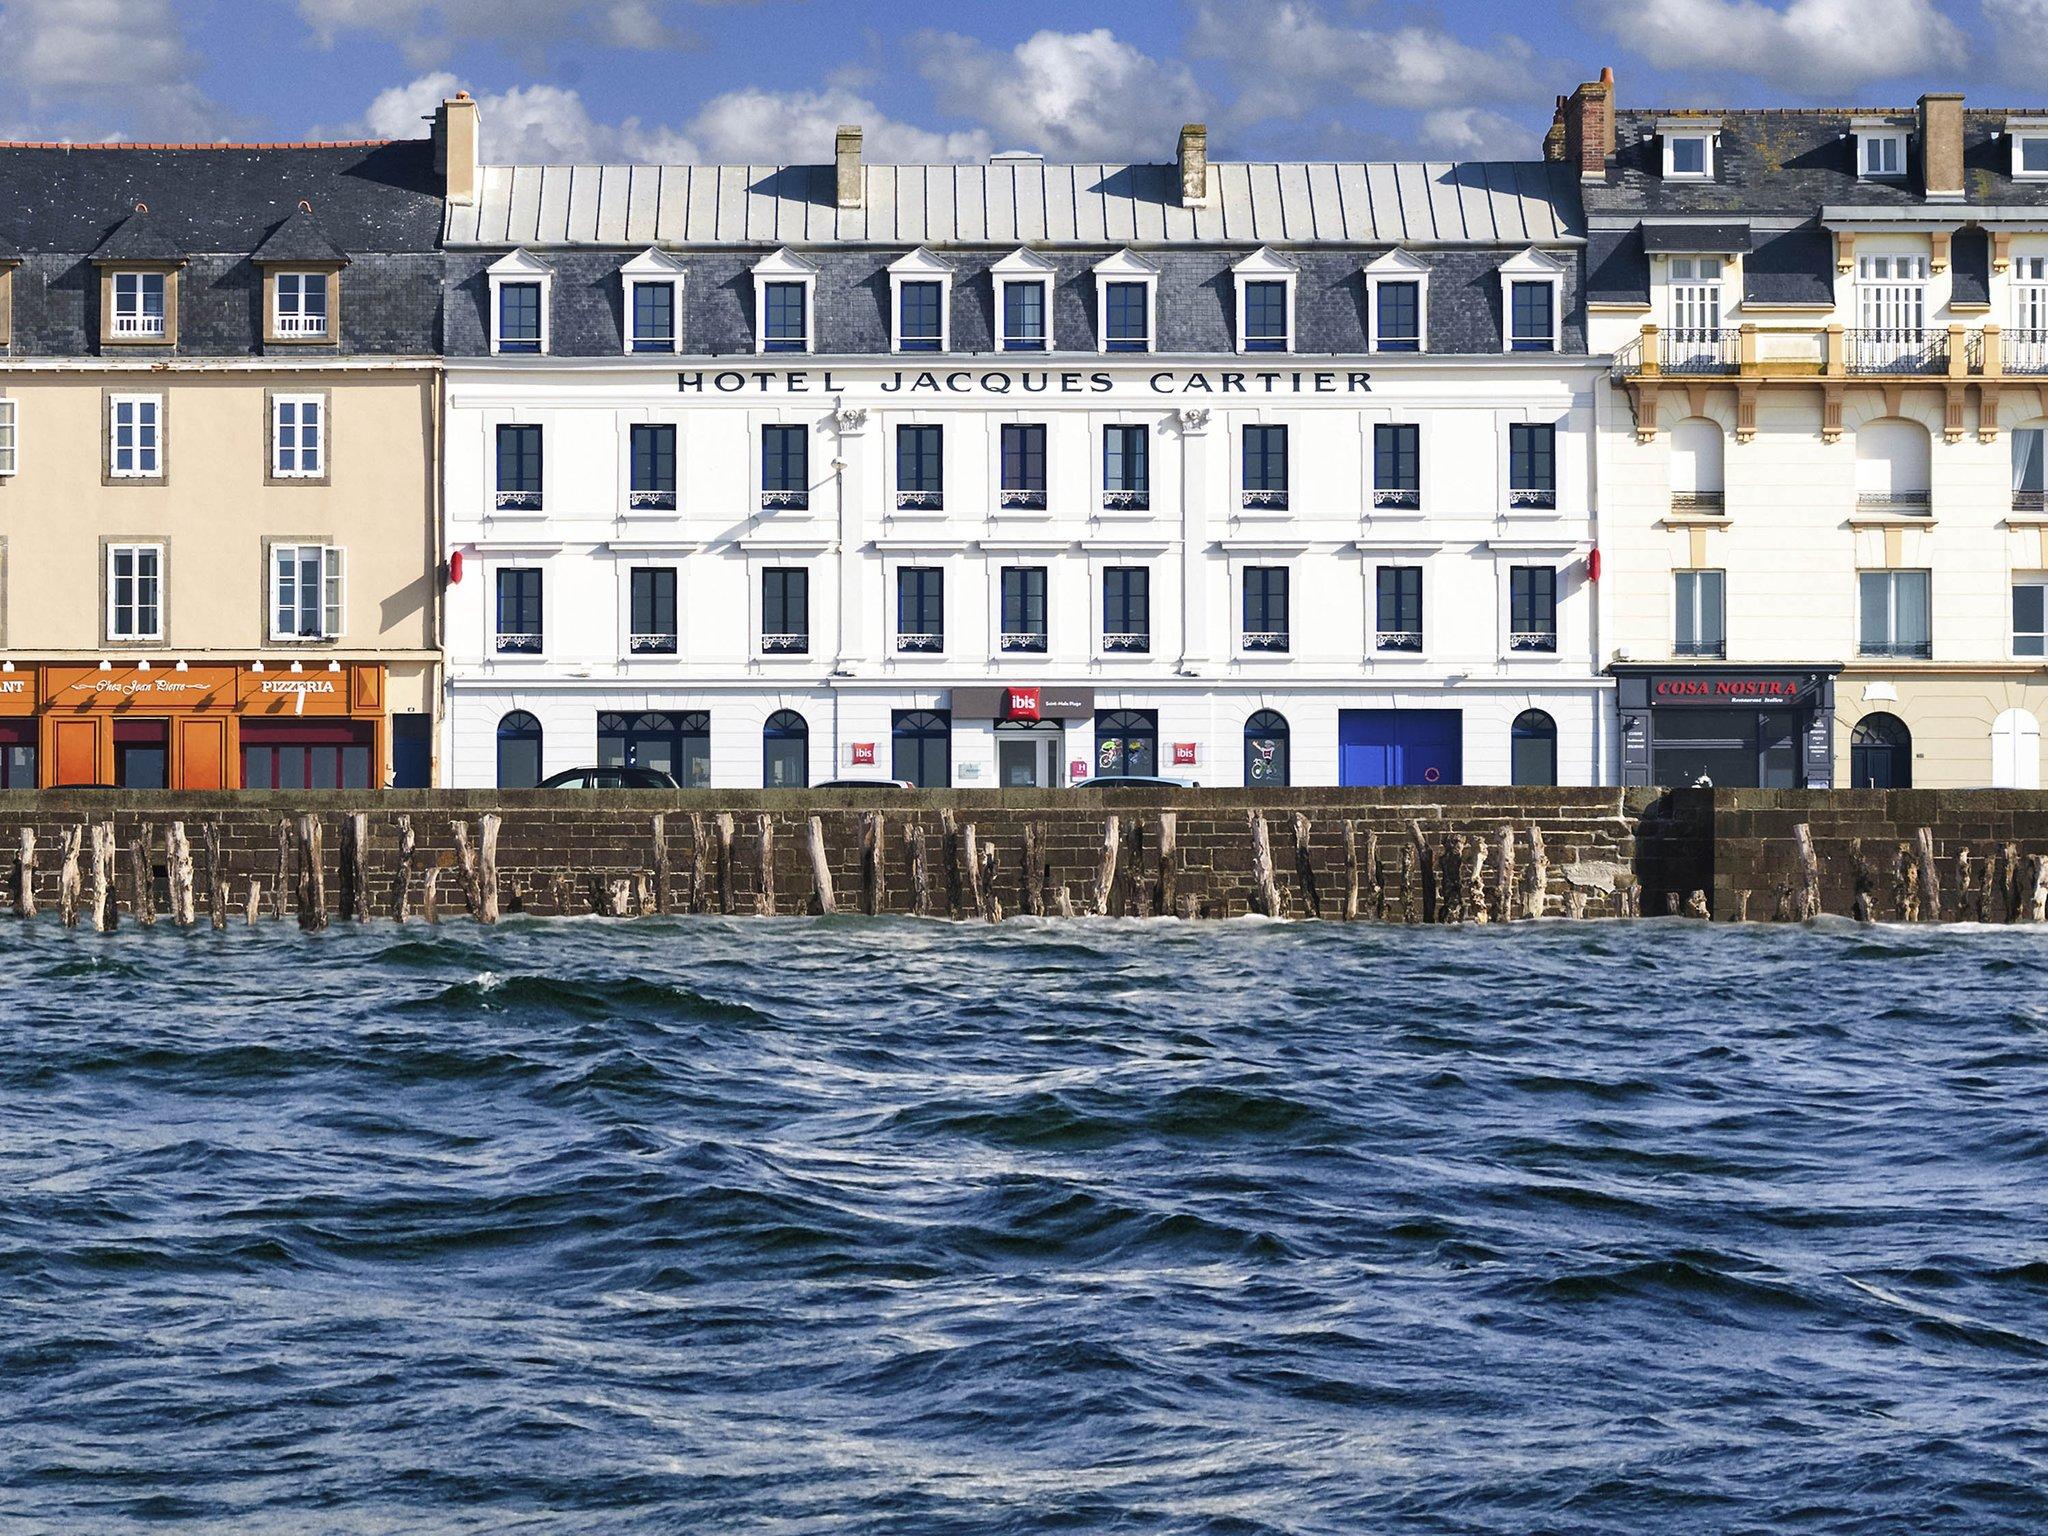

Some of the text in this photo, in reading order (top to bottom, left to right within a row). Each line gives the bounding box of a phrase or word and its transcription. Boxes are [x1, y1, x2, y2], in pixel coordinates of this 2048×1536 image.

[677, 372, 1372, 393] HOTEL JACQUES CARTIER
[0, 681, 24, 693] NT
[95, 680, 185, 695] Chez Jean Pierre
[1656, 682, 1798, 695] COSA NOSTRA
[1012, 695, 1036, 708] ibis
[856, 748, 872, 757] ibis
[1177, 748, 1194, 757] ibis
[1078, 763, 1086, 771] H
